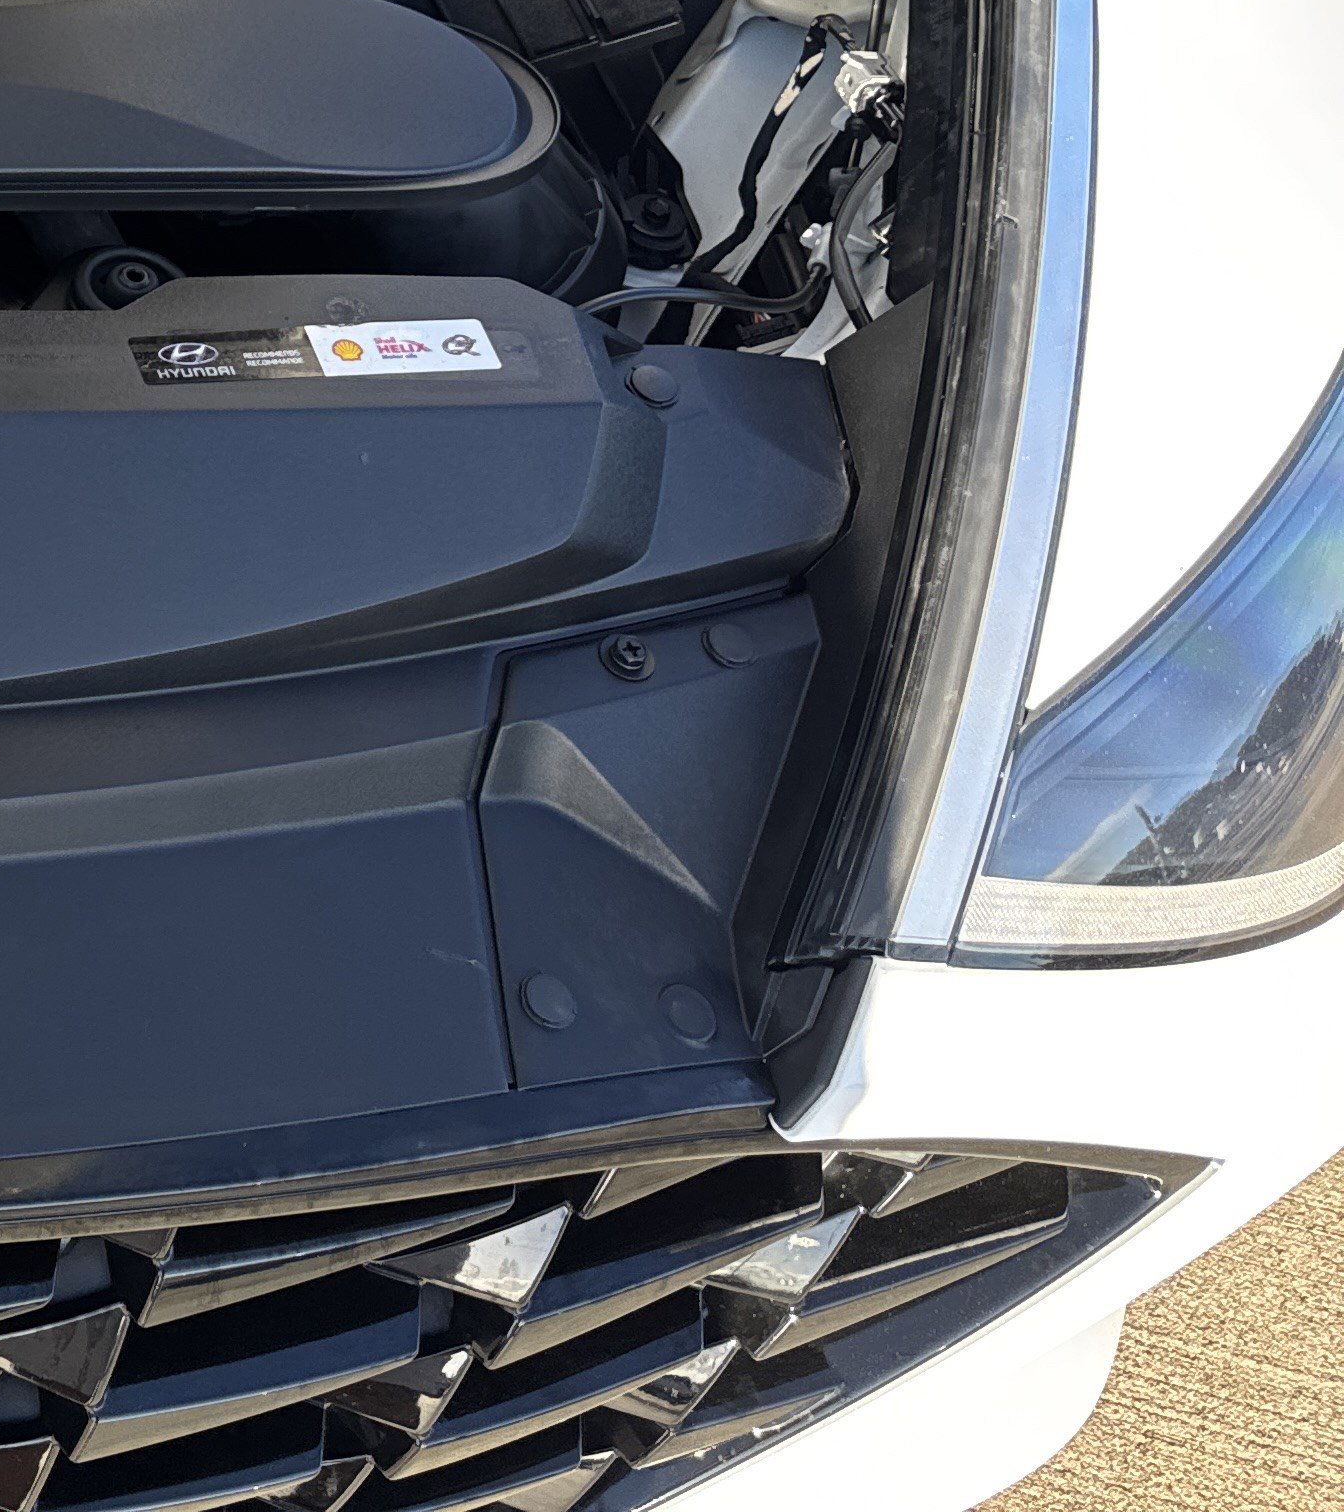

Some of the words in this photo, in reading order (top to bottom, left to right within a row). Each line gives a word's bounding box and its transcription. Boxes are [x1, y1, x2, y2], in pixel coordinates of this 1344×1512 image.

[376, 342, 425, 354] HELIX
[243, 350, 301, 360] RECOMMENDS
[157, 365, 236, 380] HYUNDAI
